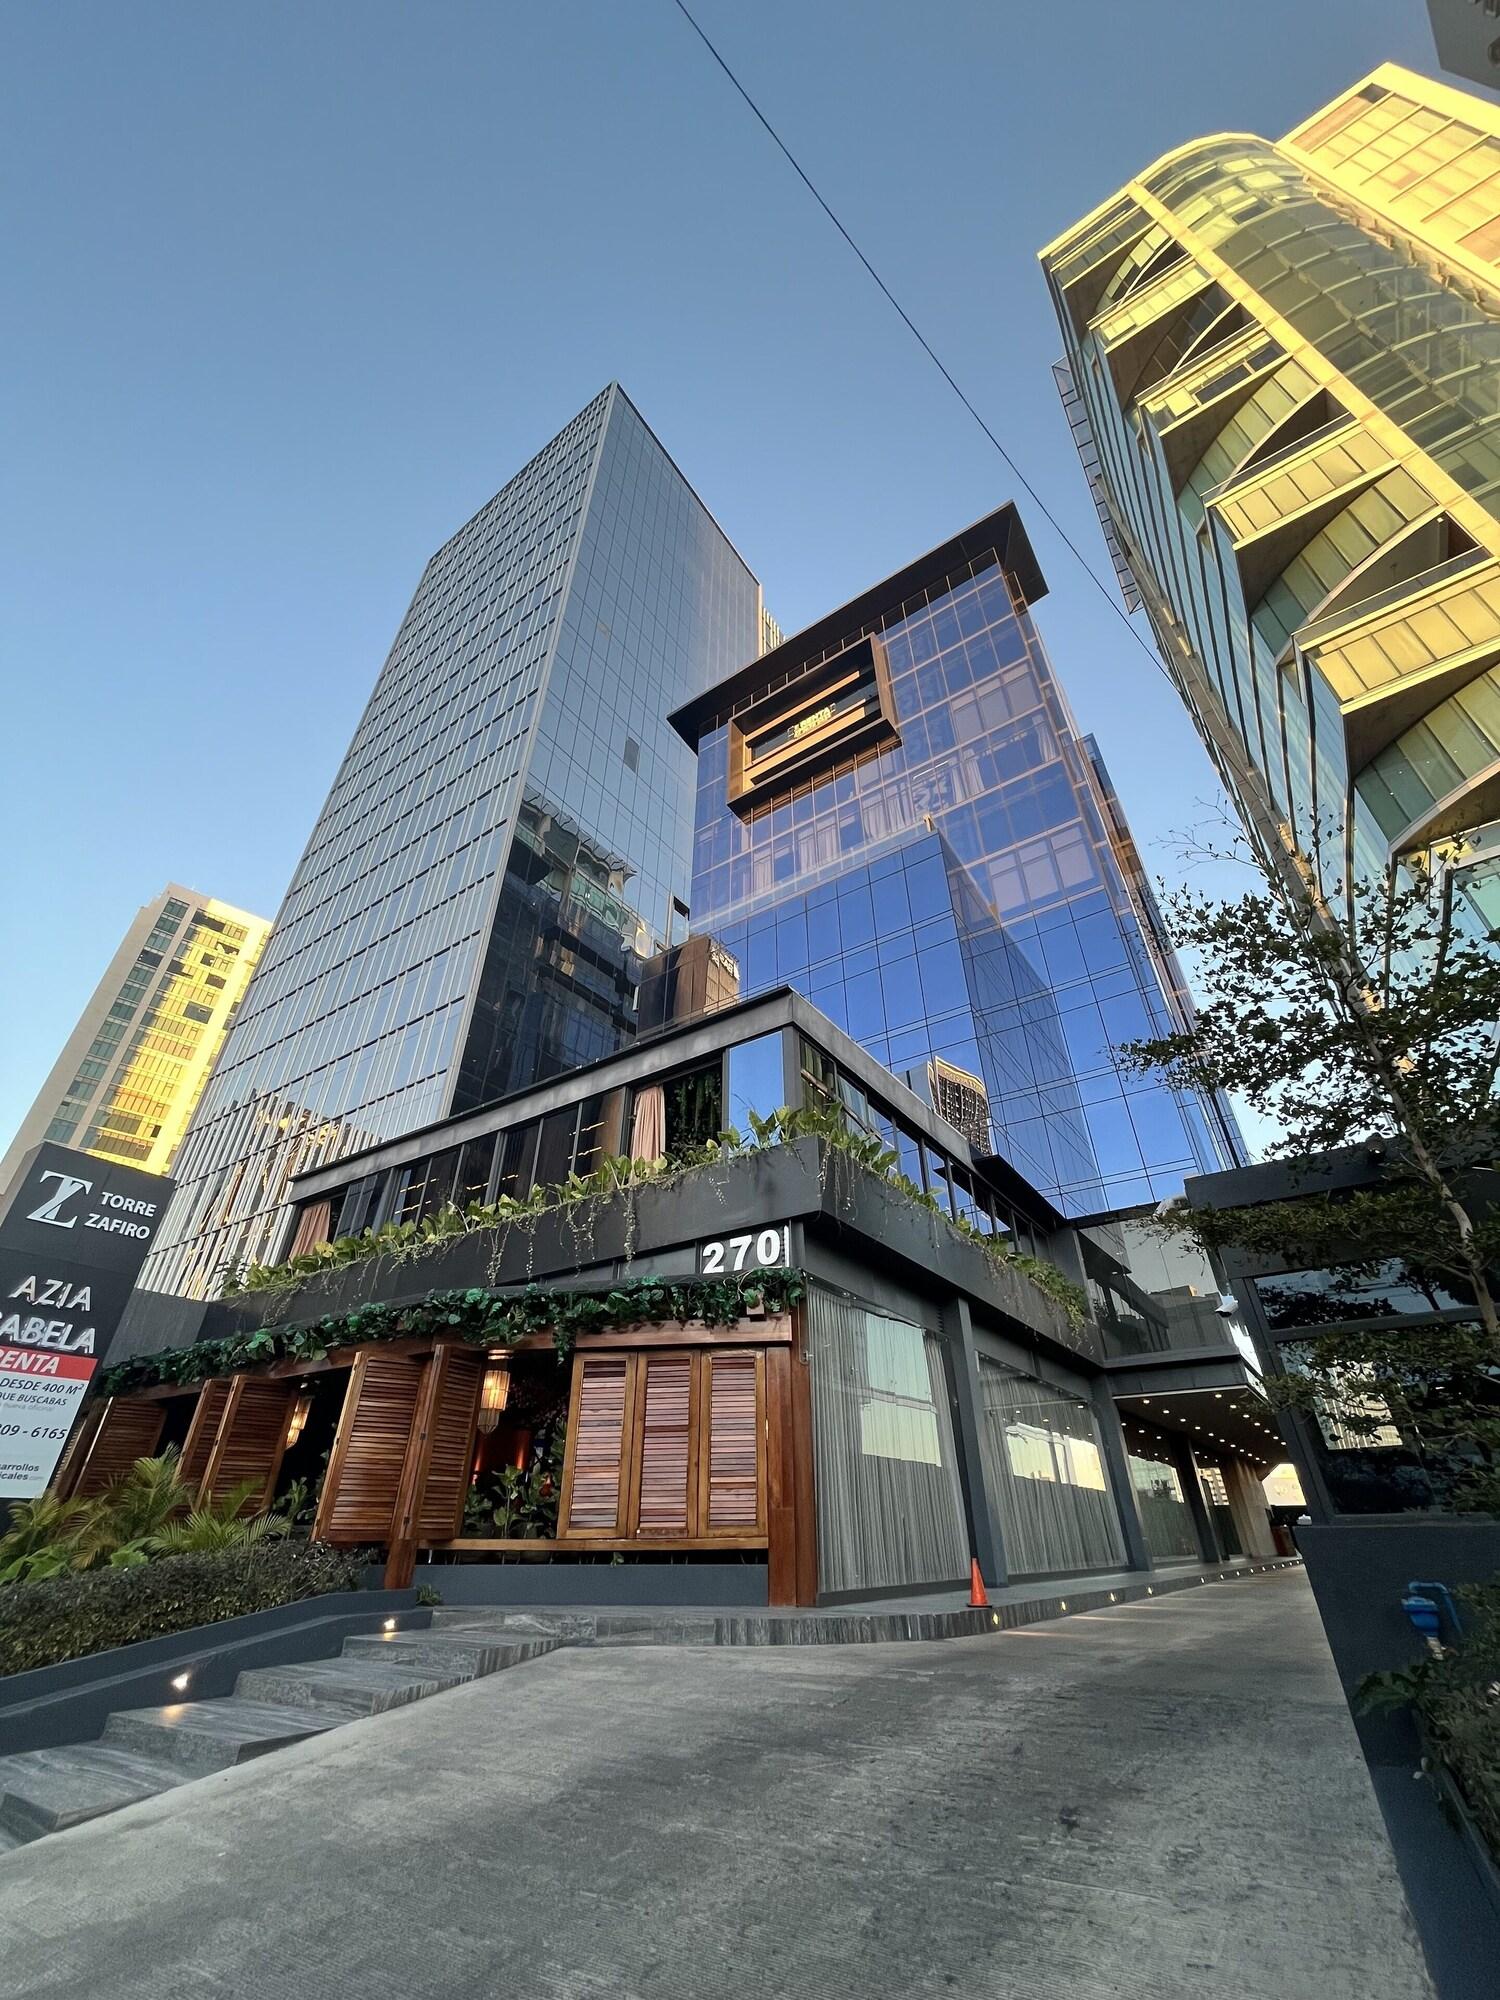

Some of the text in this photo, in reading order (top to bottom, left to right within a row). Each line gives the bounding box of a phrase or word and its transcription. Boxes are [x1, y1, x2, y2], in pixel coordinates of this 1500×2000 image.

[101, 1191, 157, 1217] TORRE
[84, 1213, 150, 1240] ZAFIRO
[8, 1275, 91, 1312] AZIA
[0, 1311, 95, 1354] ABELA
[0, 1377, 41, 1391] DESDE
[42, 1382, 65, 1394] 400
[17, 1393, 67, 1406] BUSCABAS
[0, 1423, 21, 1436] 09
[31, 1426, 67, 1440] 6165
